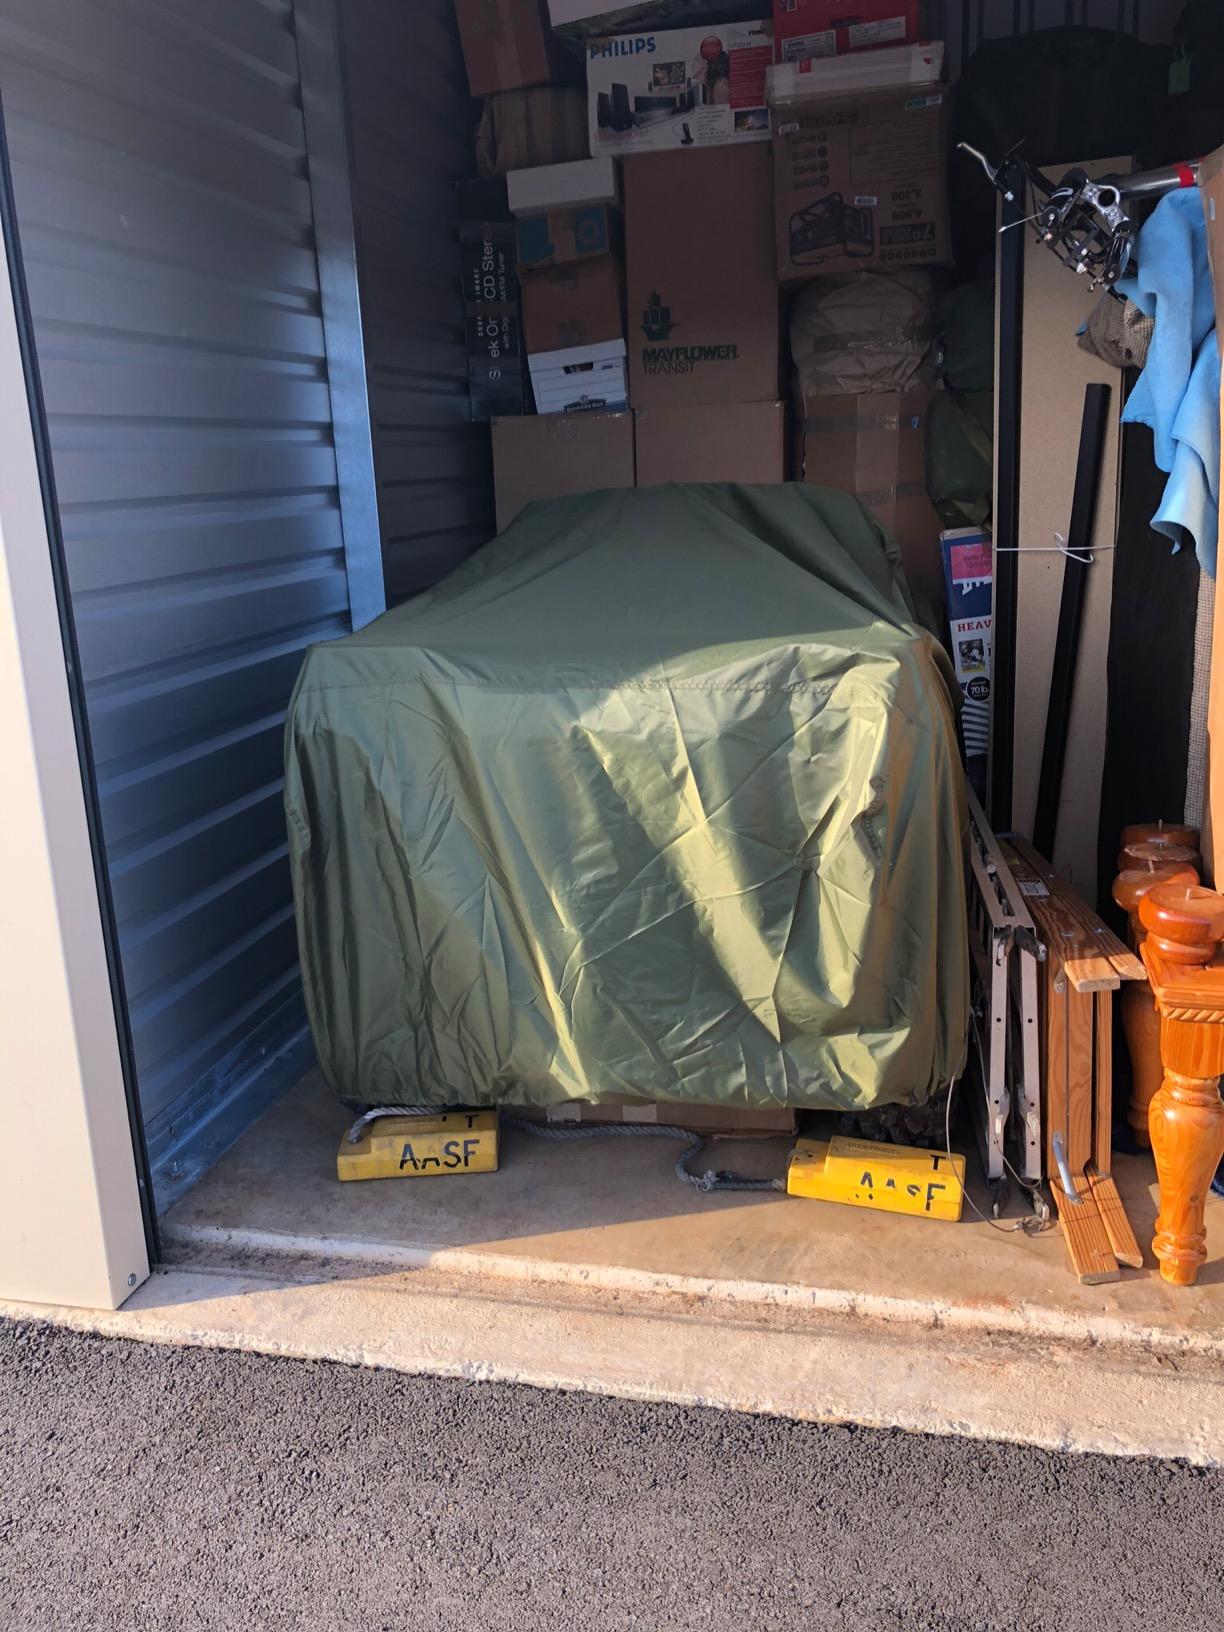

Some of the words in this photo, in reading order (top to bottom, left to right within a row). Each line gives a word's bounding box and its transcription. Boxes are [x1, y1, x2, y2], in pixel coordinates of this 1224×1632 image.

[590, 36, 656, 59] PHILIPS
[497, 252, 505, 274] Tuner
[483, 275, 499, 336] On-CD
[486, 340, 501, 380] Sek
[641, 360, 695, 375] TRANSIT
[957, 619, 992, 632] HEAV
[970, 686, 980, 695] 70
[929, 1153, 946, 1170] T
